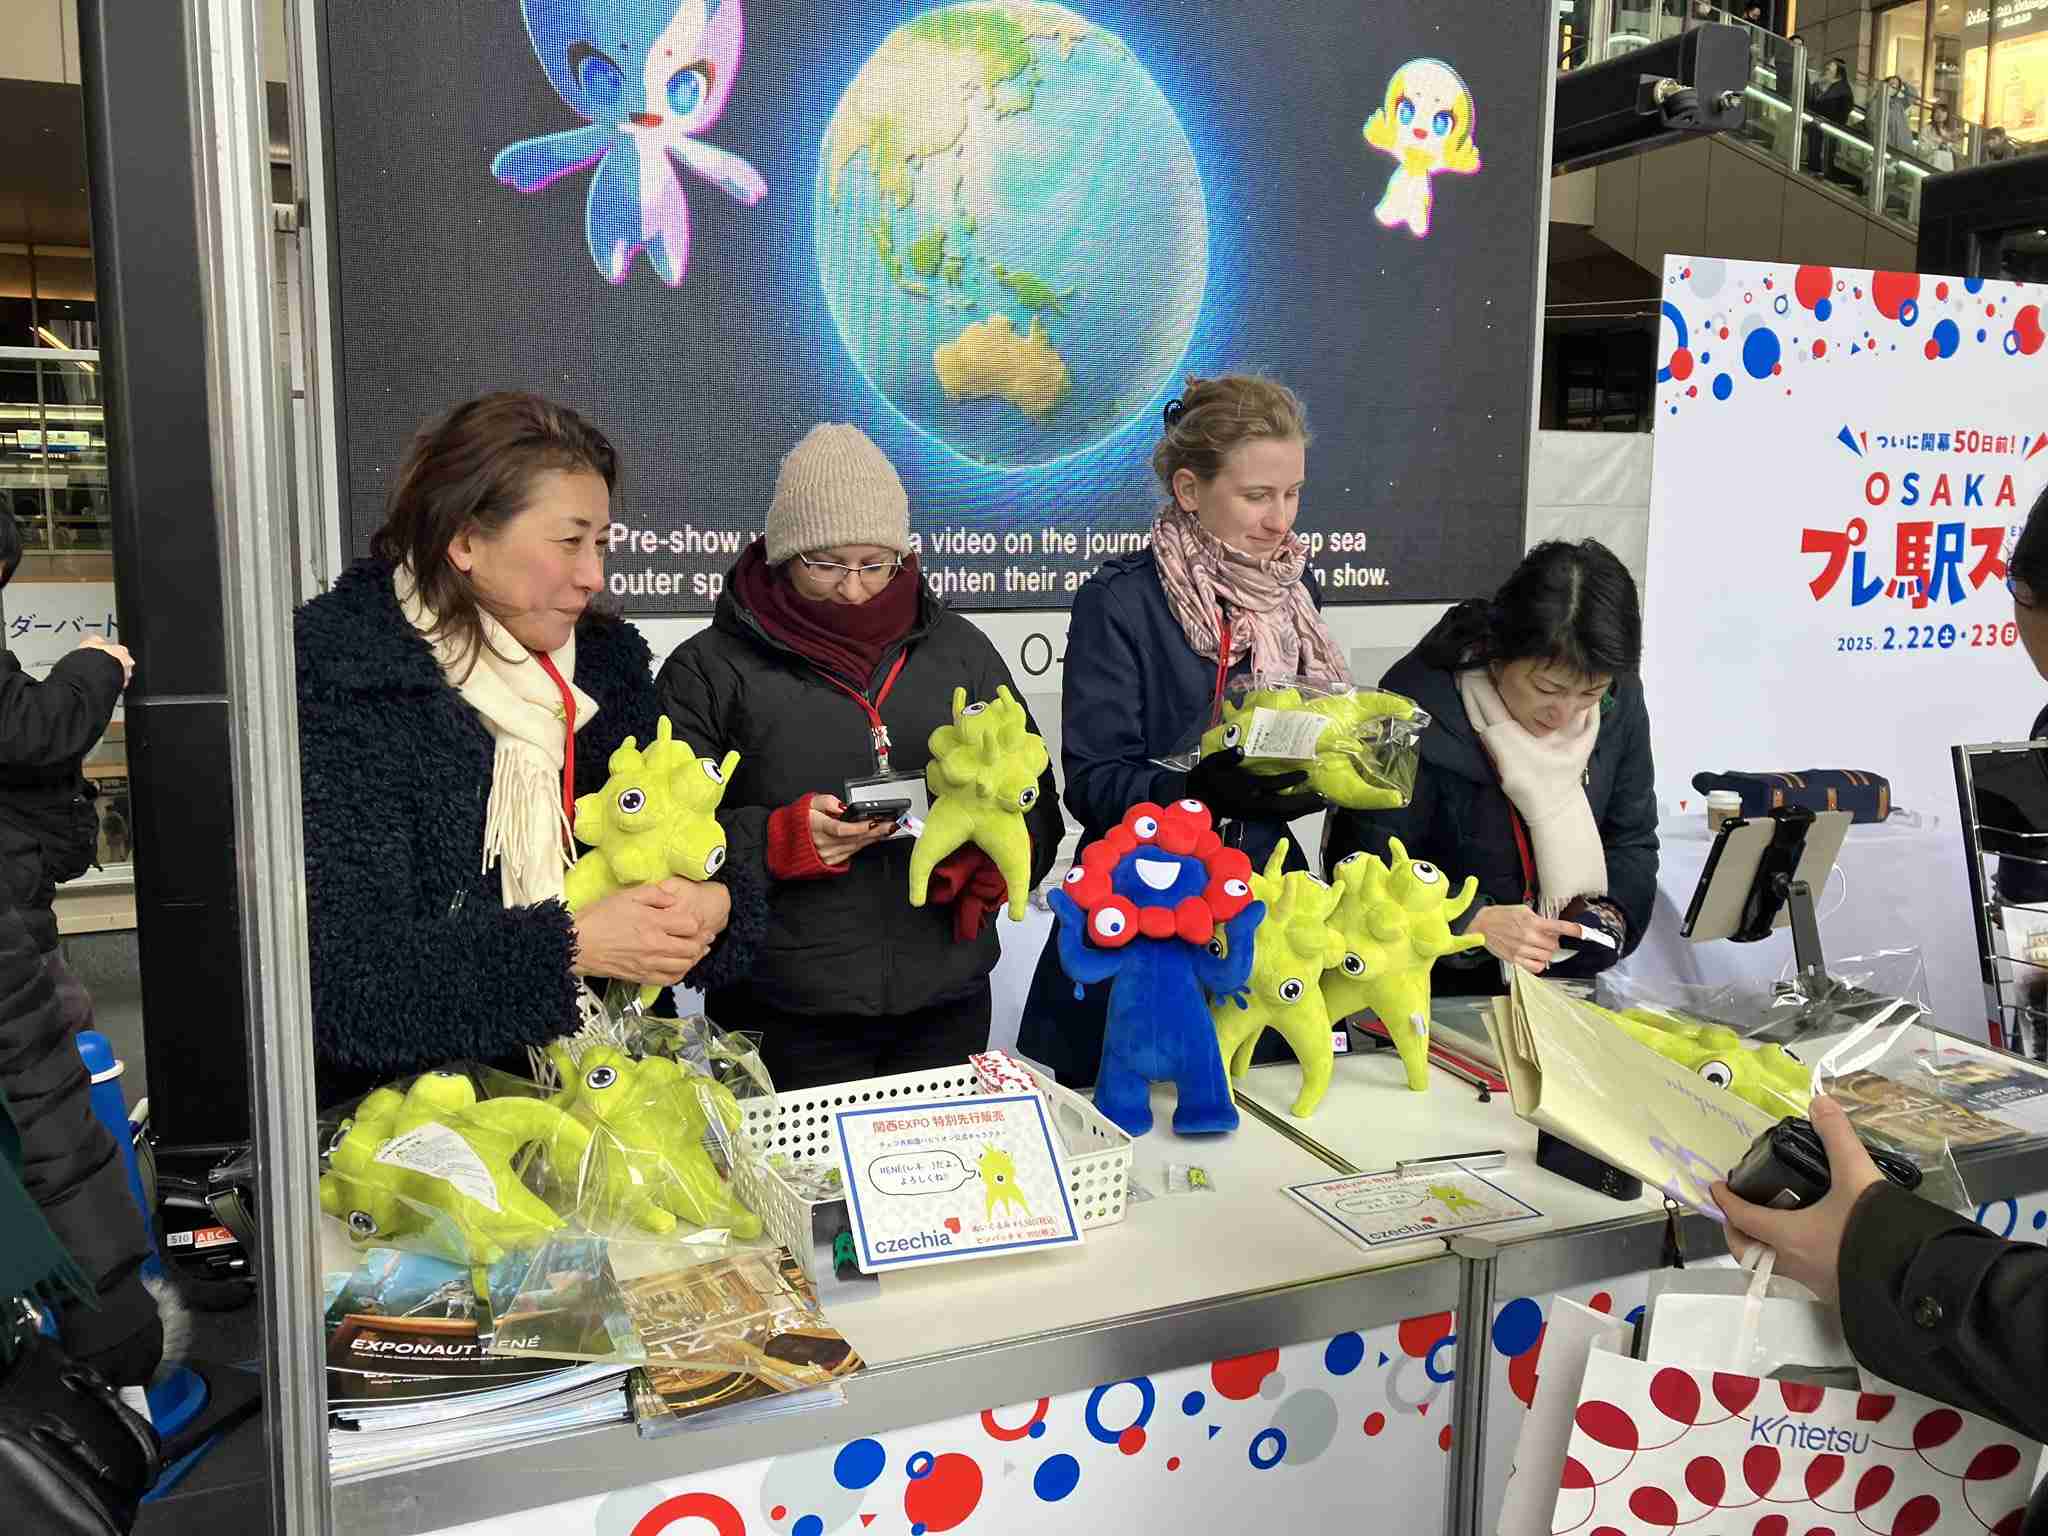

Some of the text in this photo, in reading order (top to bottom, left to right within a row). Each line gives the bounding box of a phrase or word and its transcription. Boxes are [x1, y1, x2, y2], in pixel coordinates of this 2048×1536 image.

[1876, 429, 2016, 454] ついに開幕50日前!
[1865, 471, 2017, 507] OSAKA
[608, 522, 740, 553] Pre-show
[931, 527, 997, 554] video
[1004, 532, 1032, 554] on
[1042, 527, 1077, 554] the
[1085, 527, 1152, 560] journe
[1299, 532, 1323, 557] ep
[1328, 531, 1367, 552] sea
[609, 568, 684, 595] outer
[923, 566, 996, 599] ighten
[1005, 566, 1057, 592] their
[1333, 562, 1390, 587] show.
[1800, 517, 2008, 609] プレ駅ス
[875, 1229, 953, 1255] czechia
[350, 1338, 477, 1357] EXPONAUT
[1749, 1414, 1872, 1455] Kintetsu
